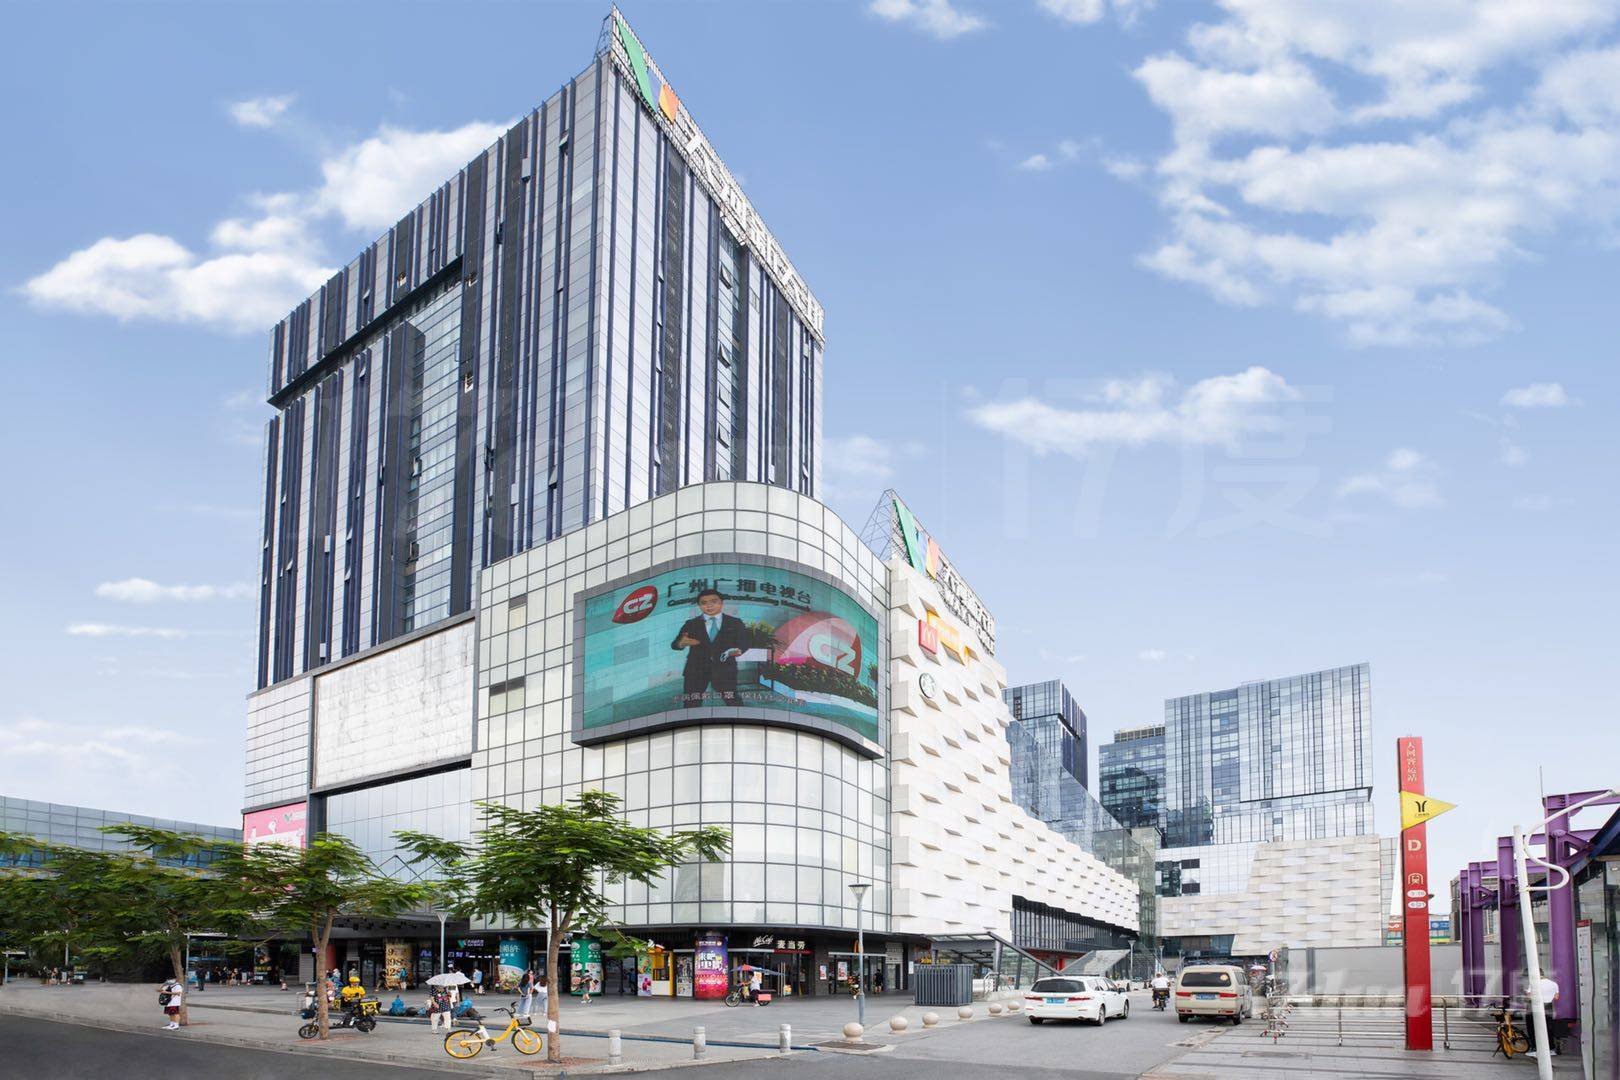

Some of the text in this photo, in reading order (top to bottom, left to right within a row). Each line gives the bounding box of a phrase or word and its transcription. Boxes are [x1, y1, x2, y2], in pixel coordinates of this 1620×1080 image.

[667, 578, 812, 604] 广州广播电视台
[1407, 839, 1422, 852] D
[777, 940, 805, 949] 麦当劳
